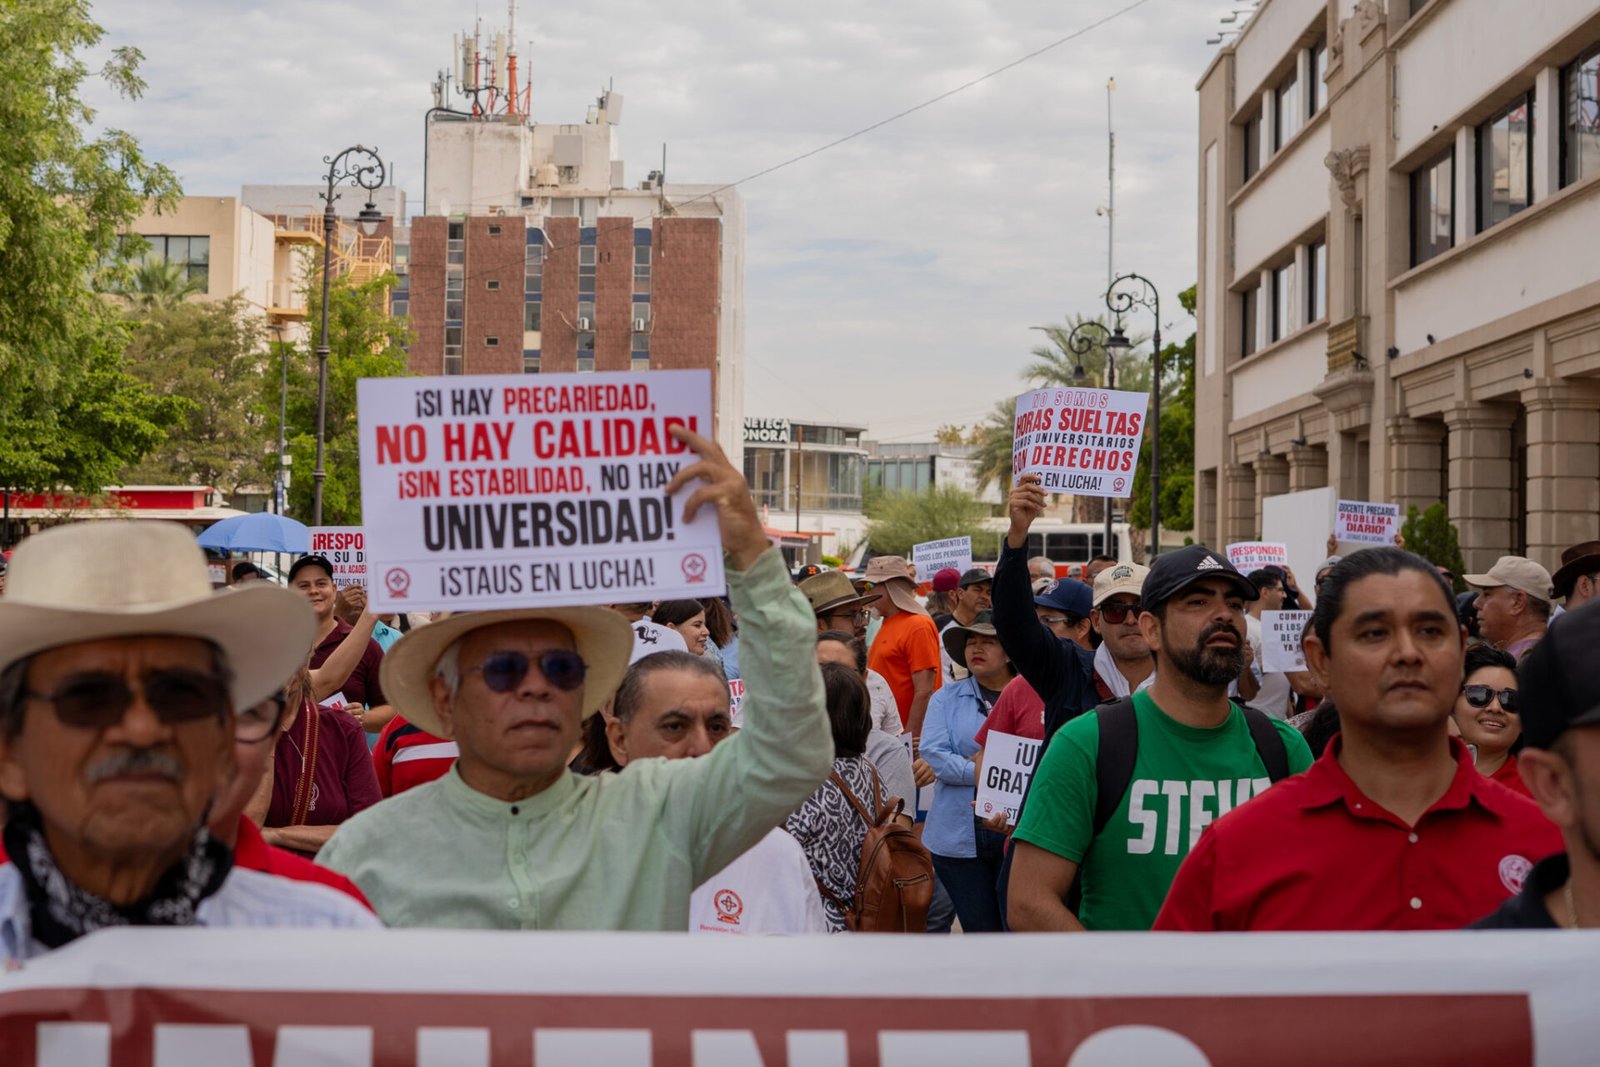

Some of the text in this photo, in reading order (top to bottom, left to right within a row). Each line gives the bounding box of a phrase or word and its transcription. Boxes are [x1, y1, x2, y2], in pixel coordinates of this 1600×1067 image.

[416, 384, 656, 417] ¡SI HAY PRECARIEDAD,
[1055, 390, 1109, 408] SOMOS
[1015, 407, 1142, 439] HORAS SUELTAS
[376, 424, 427, 464] NO
[443, 422, 515, 462] HAY
[1035, 432, 1135, 449] UNIVERSITARIOS
[1013, 445, 1133, 475] CON DERECHOS
[398, 470, 440, 500] ¡SIN
[451, 466, 592, 498] ESTABILIDAD,
[601, 465, 630, 491] NO
[1044, 473, 1060, 488] EN
[1062, 474, 1103, 491] LUCHA!
[423, 498, 676, 551] UNIVERSIDAD!
[1340, 512, 1392, 524] PROBLEMA
[1346, 523, 1385, 535] DIARIO!
[313, 532, 365, 551] ¡RESPO
[334, 551, 350, 563] SU
[356, 551, 367, 563] D
[440, 559, 655, 597] ¡STAUS EN LUCHA!
[1273, 623, 1302, 631] DE LOS
[1280, 634, 1291, 642] DE
